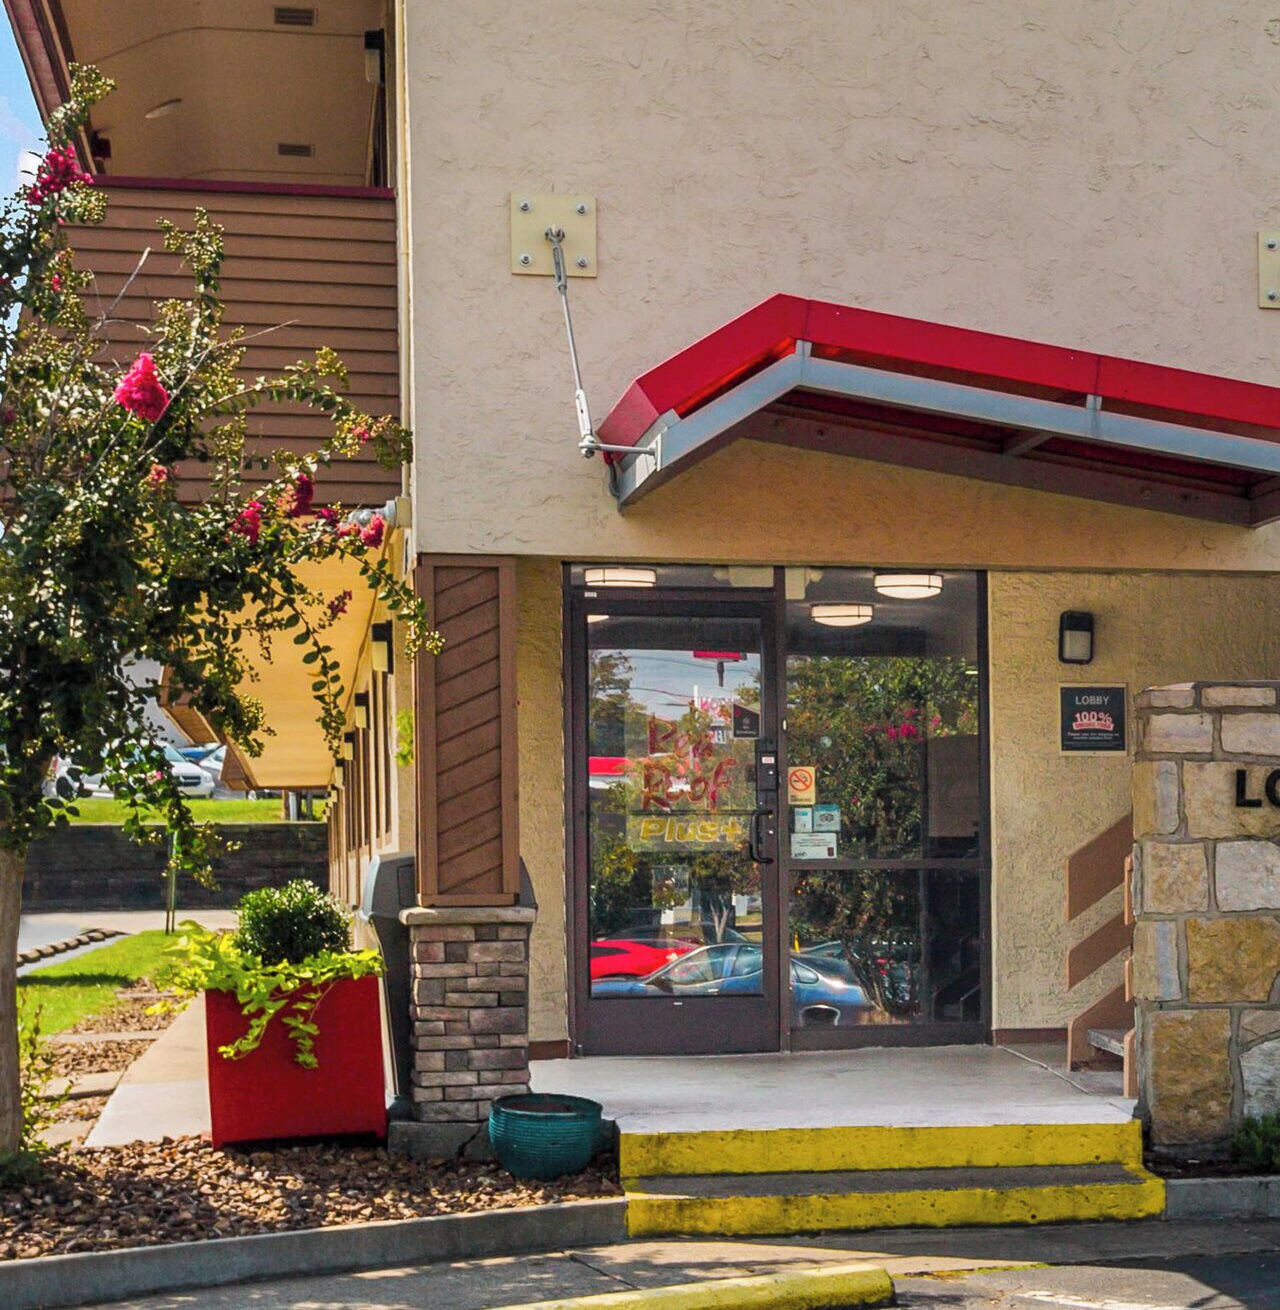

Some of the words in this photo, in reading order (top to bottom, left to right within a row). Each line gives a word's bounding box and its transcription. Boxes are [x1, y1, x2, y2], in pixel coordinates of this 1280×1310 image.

[1075, 695, 1110, 706] LOBBY
[1074, 711, 1113, 724] 100%
[639, 817, 743, 842] Plus+
